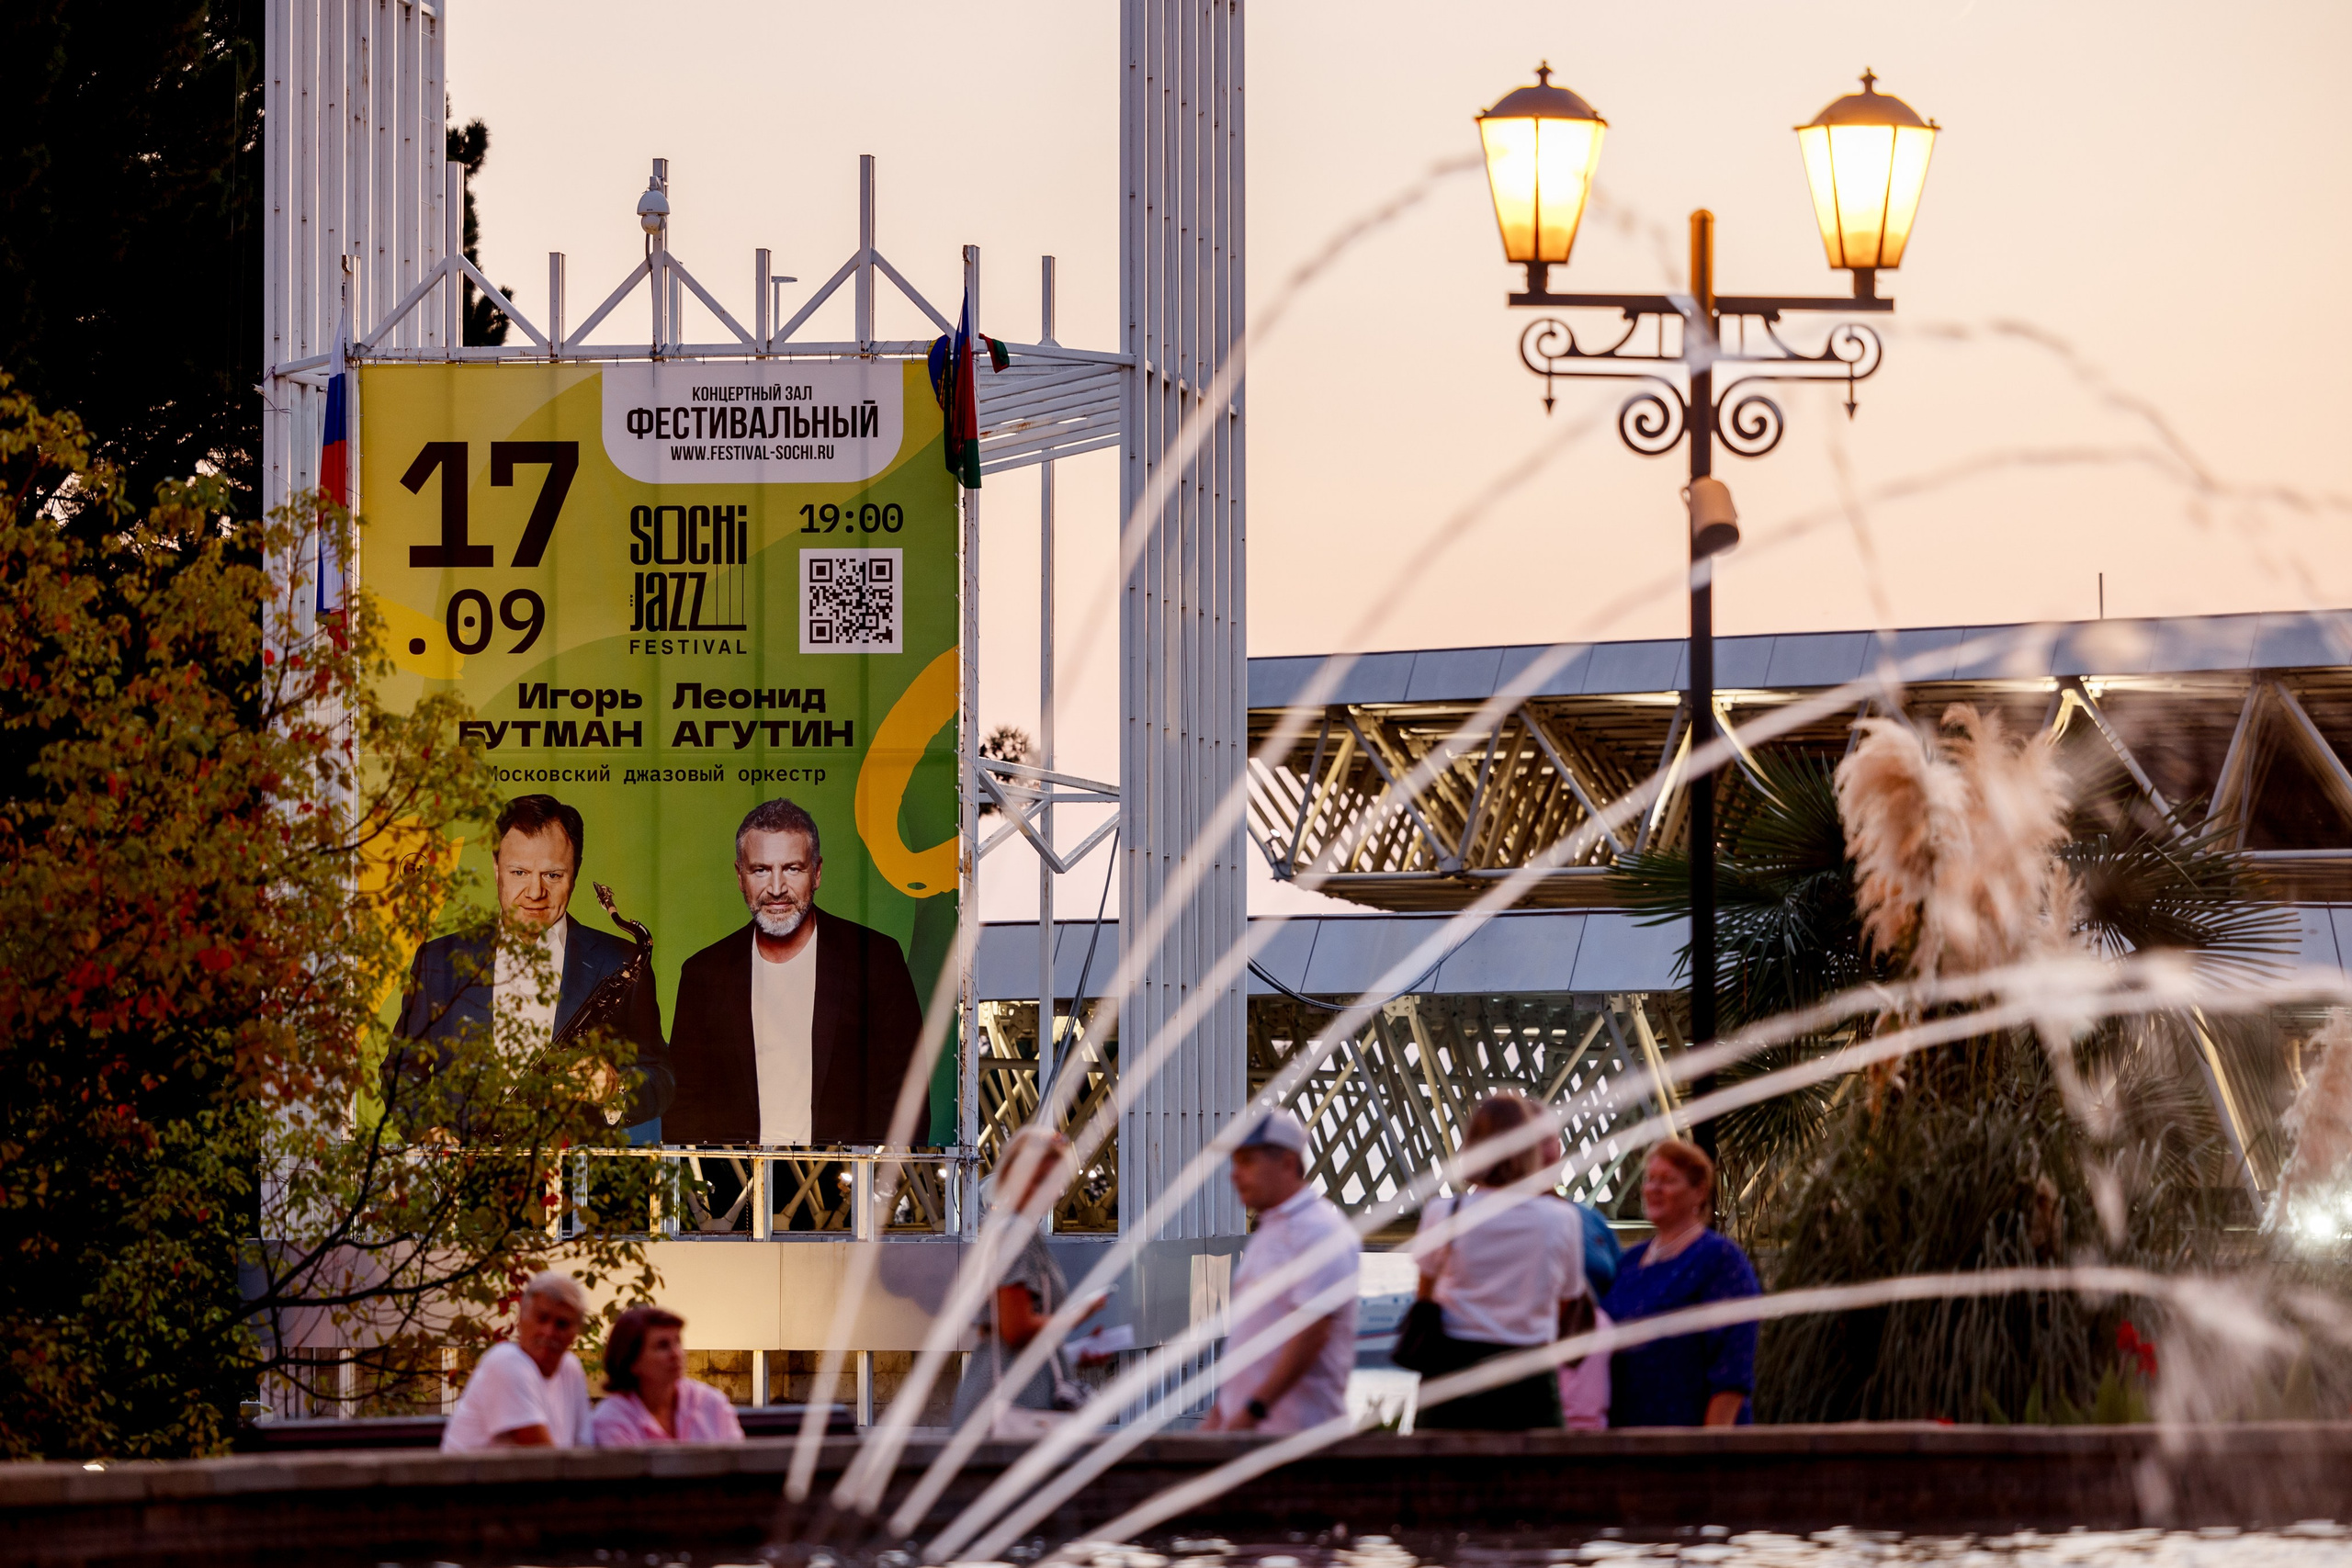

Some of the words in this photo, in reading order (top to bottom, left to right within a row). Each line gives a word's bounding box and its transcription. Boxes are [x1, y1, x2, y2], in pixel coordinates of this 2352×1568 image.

[692, 384, 781, 402] КОНЦЕРТНЫЙ
[785, 386, 812, 400] ЗАЛ
[627, 400, 878, 440] ФЕСТИВАЛЬНЫЙ
[670, 445, 835, 461] WWW.FESTIVAL-SOCHI.RU
[400, 441, 579, 568] 17
[798, 503, 904, 534] 19:00
[630, 639, 747, 655] FESTIVAL
[518, 682, 643, 716] Игорь
[673, 682, 826, 714] Леонид
[459, 720, 643, 750] БУТМАН
[672, 720, 854, 750] АГУТИН
[623, 764, 725, 784] джазовый
[738, 769, 826, 786] оркестр
